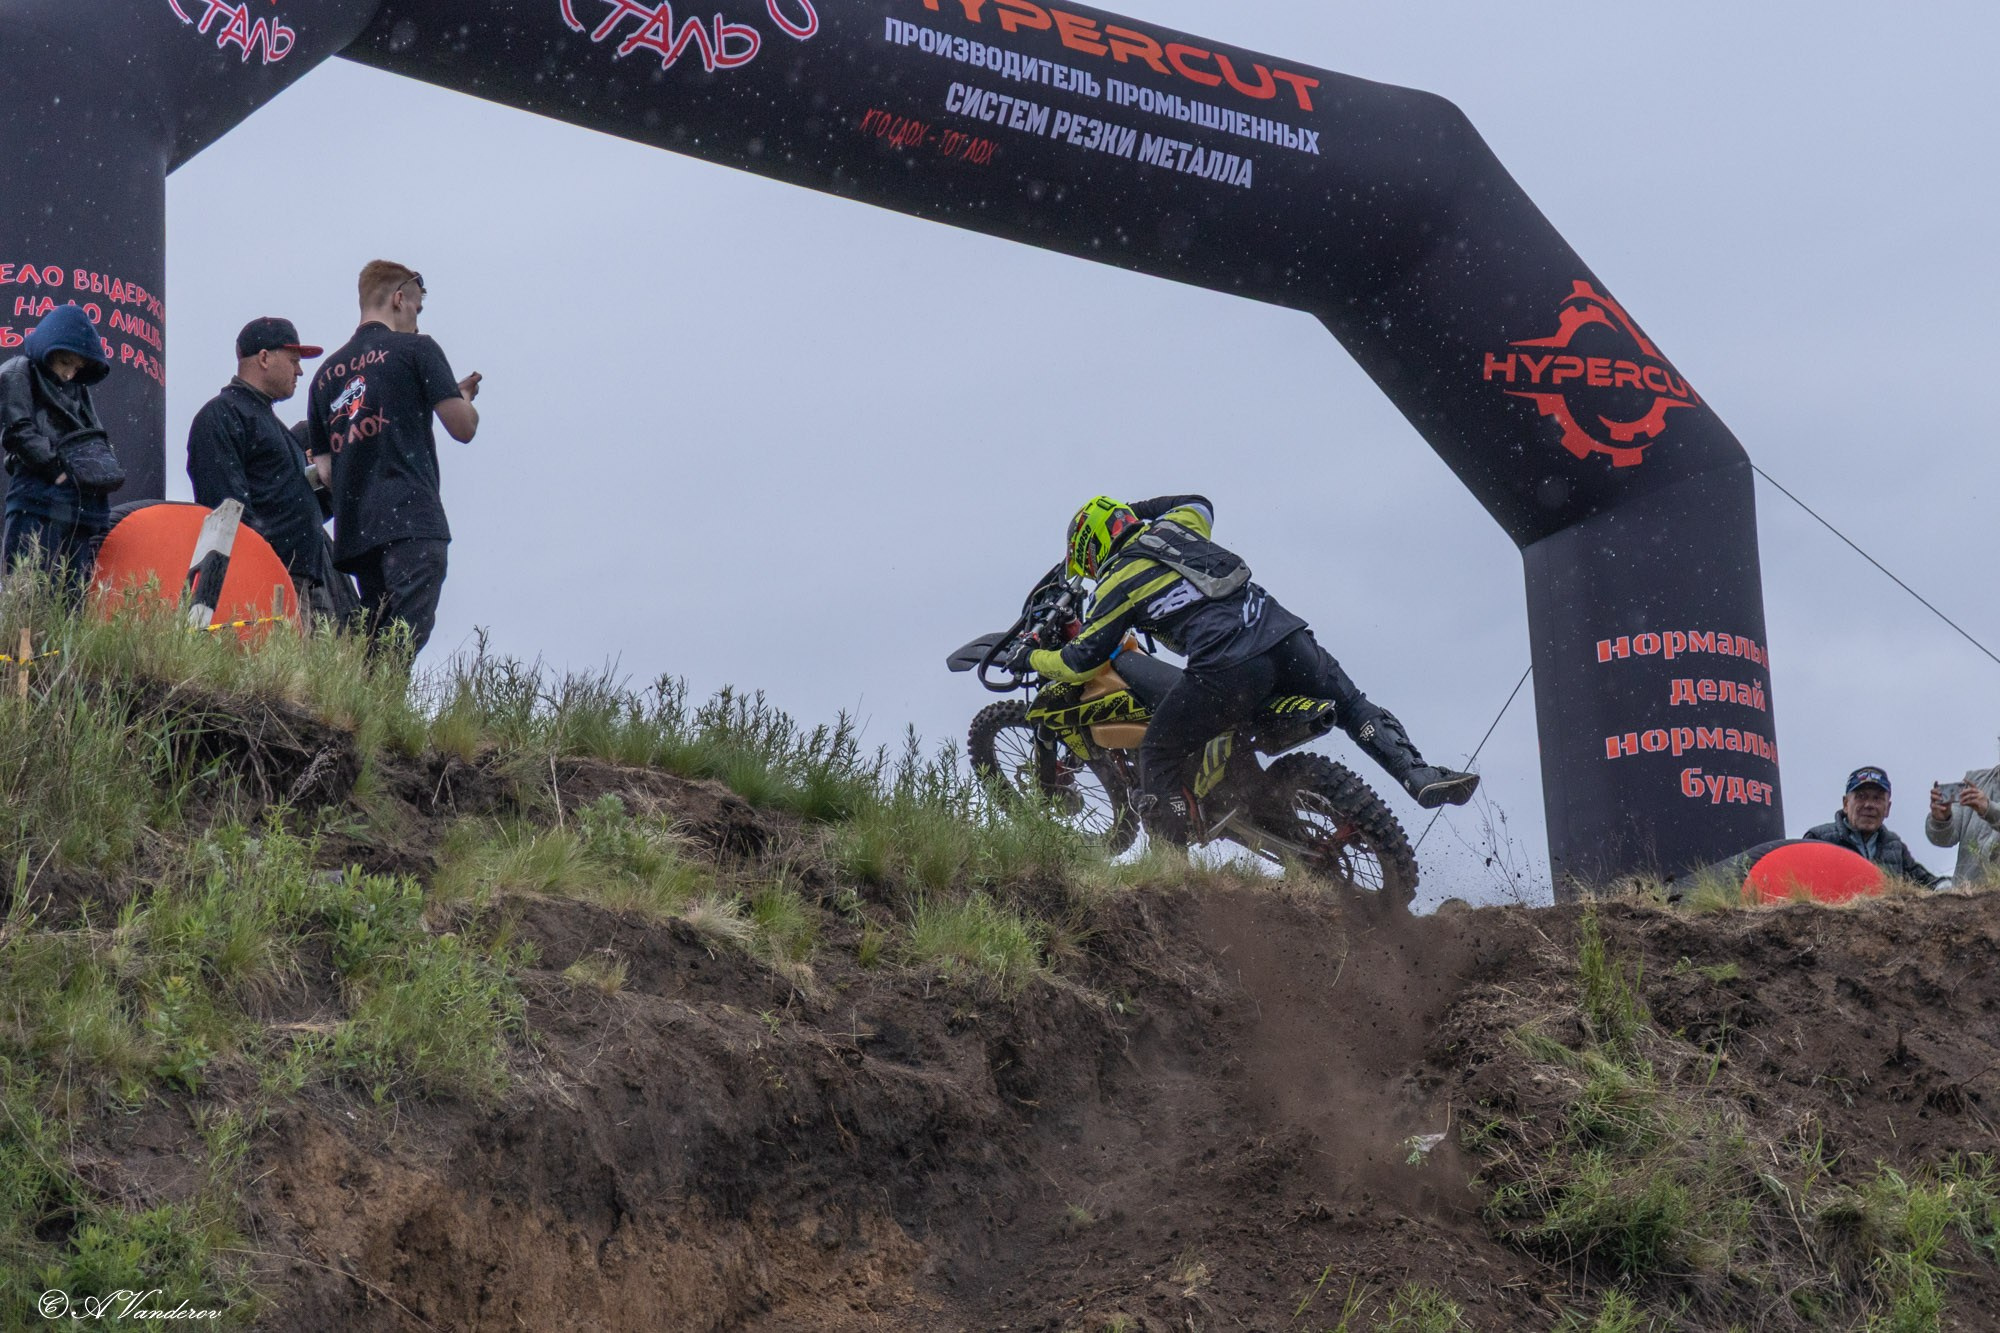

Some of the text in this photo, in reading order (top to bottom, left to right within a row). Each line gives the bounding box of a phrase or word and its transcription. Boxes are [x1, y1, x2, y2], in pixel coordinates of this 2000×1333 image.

[922, 0, 1320, 112] YPERCUT
[885, 17, 1101, 98] ПРОИЗВОДИТЕЛЬ
[1106, 77, 1320, 156] ПРОМЫШЛЕННЫХ
[859, 107, 893, 138] КТО
[945, 82, 1253, 189] СИСТЕМ РЕЗКИ МЕТАЛЛА
[14, 295, 102, 325] НАО
[109, 308, 163, 352] ЛИШЬ
[347, 406, 391, 444] ЛОХ
[1669, 678, 1767, 713] делай
[1680, 767, 1773, 807] будет
